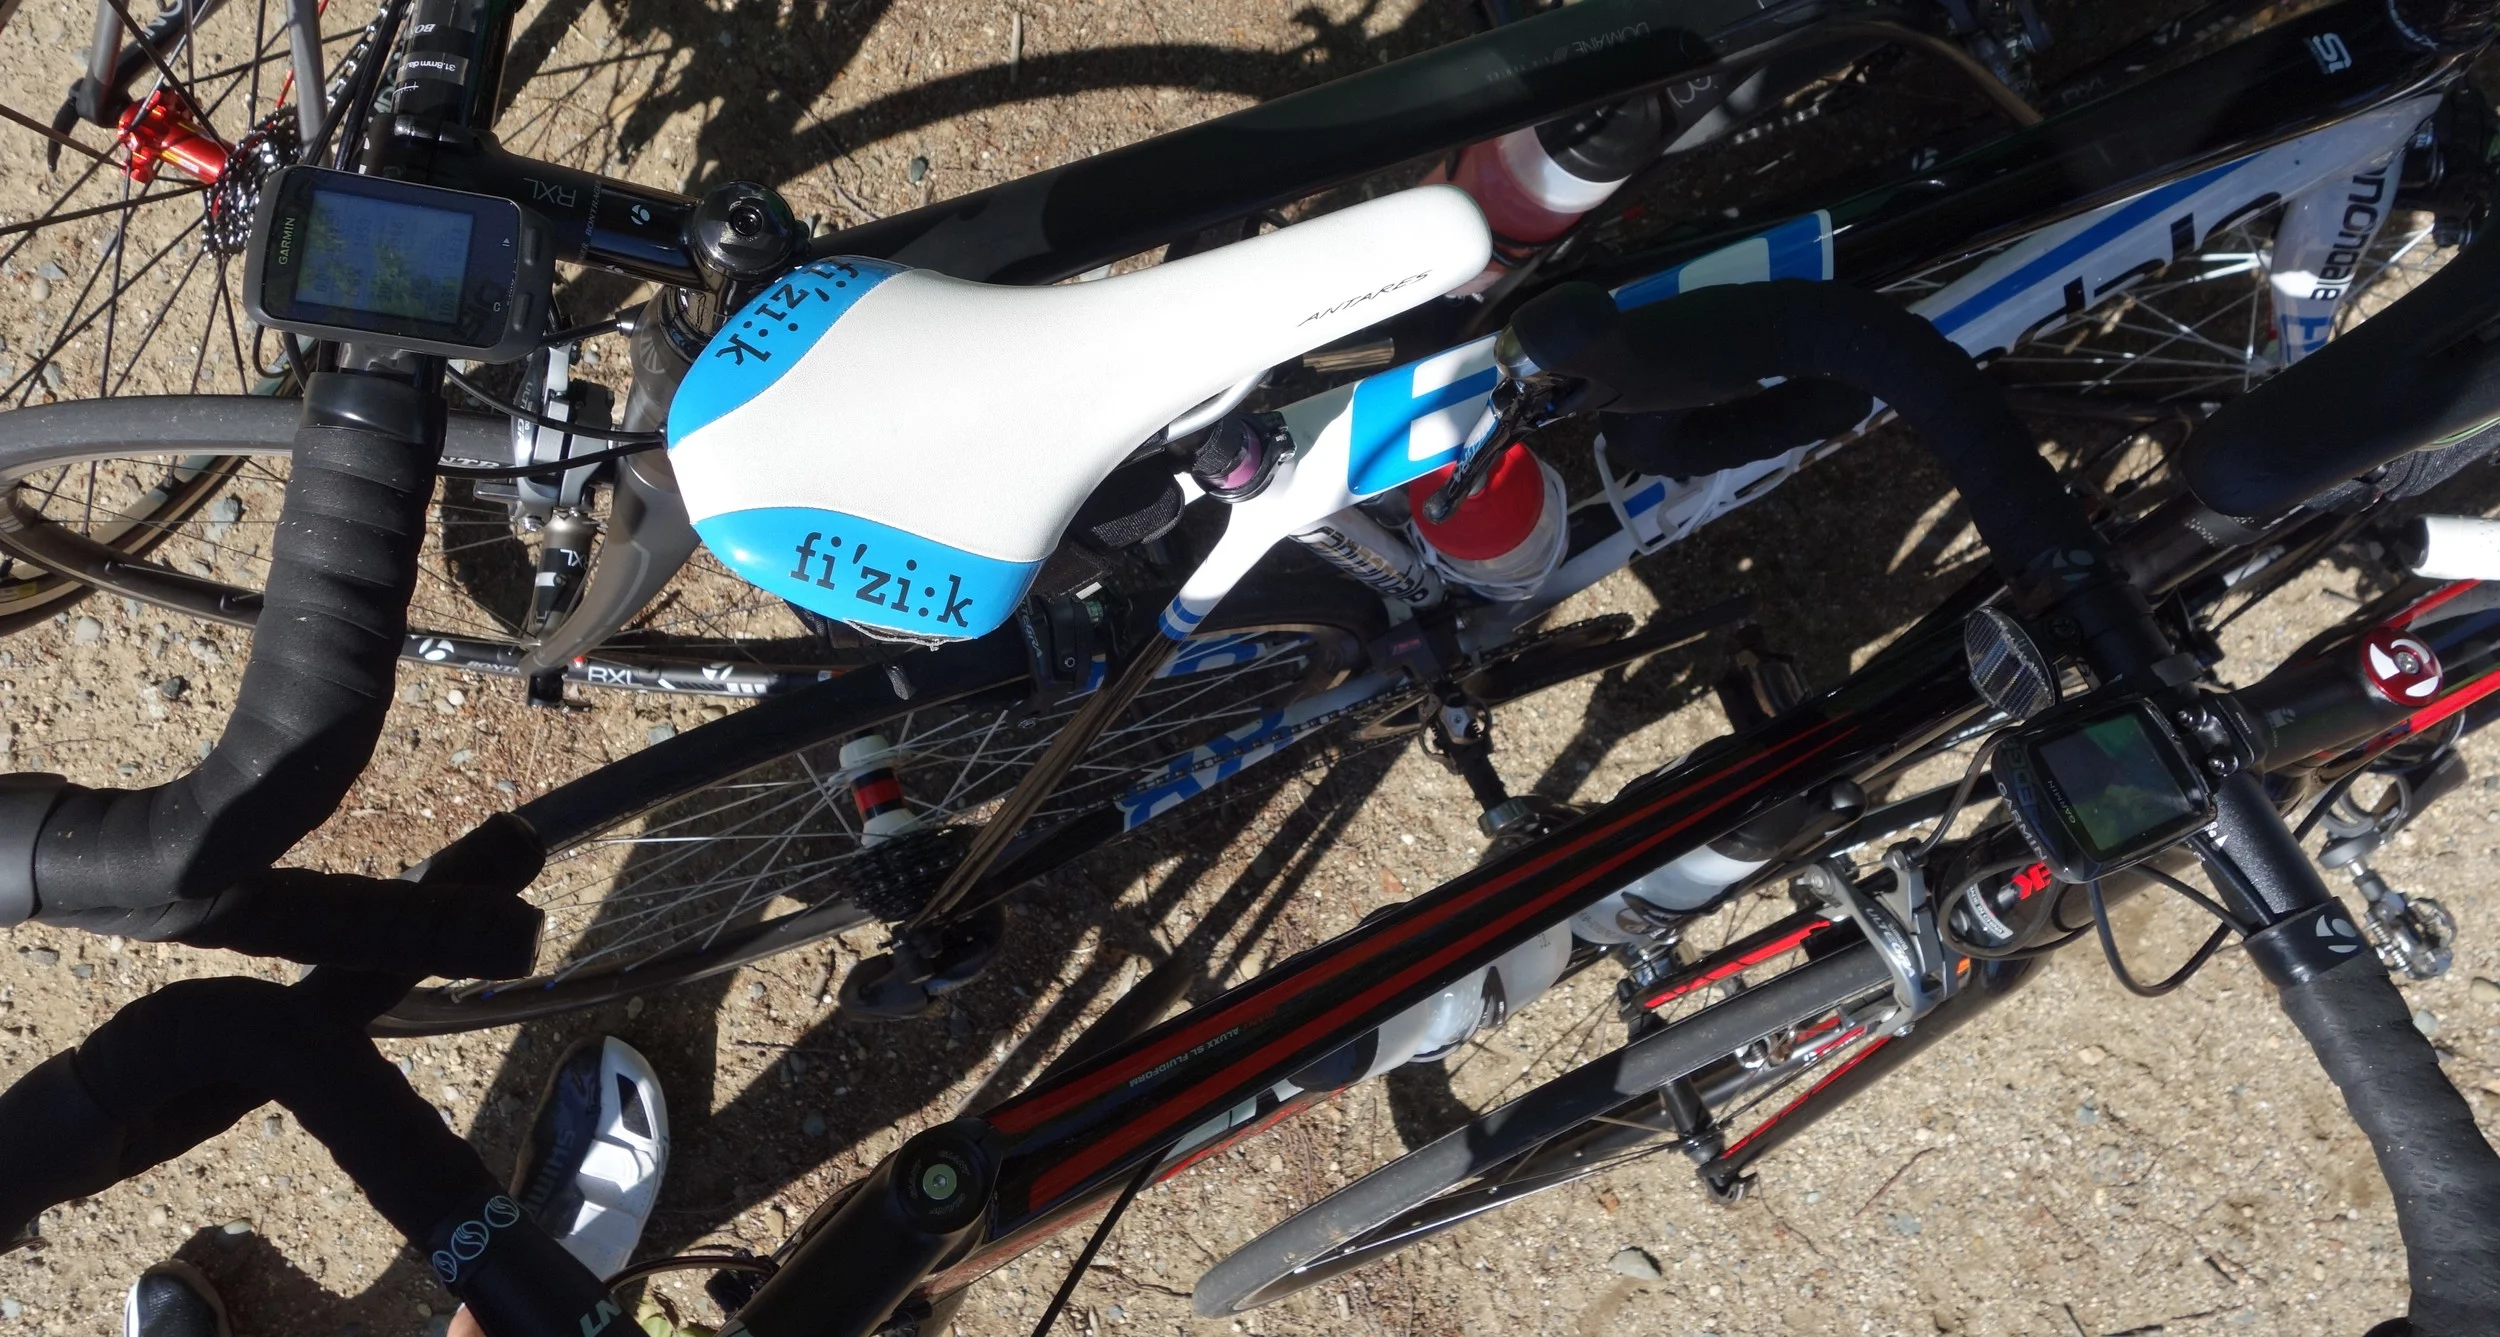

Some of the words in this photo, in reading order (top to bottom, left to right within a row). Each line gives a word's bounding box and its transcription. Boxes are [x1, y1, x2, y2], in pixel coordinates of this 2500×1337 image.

[1572, 21, 1650, 53] DOMANE
[523, 177, 577, 208] RXL
[277, 216, 297, 266] GARMIN
[1296, 268, 1433, 328] ANTARES
[587, 666, 638, 685] RXL
[2047, 780, 2076, 824] GARMIN
[1998, 781, 2048, 861] GARMIN
[1982, 911, 2005, 934] CHINA
[1865, 907, 1916, 978] ULTEGRA
[1191, 1046, 1205, 1056] SL
[1207, 1026, 1241, 1049] ALUXX
[1128, 1054, 1190, 1088] FLUIDFORM
